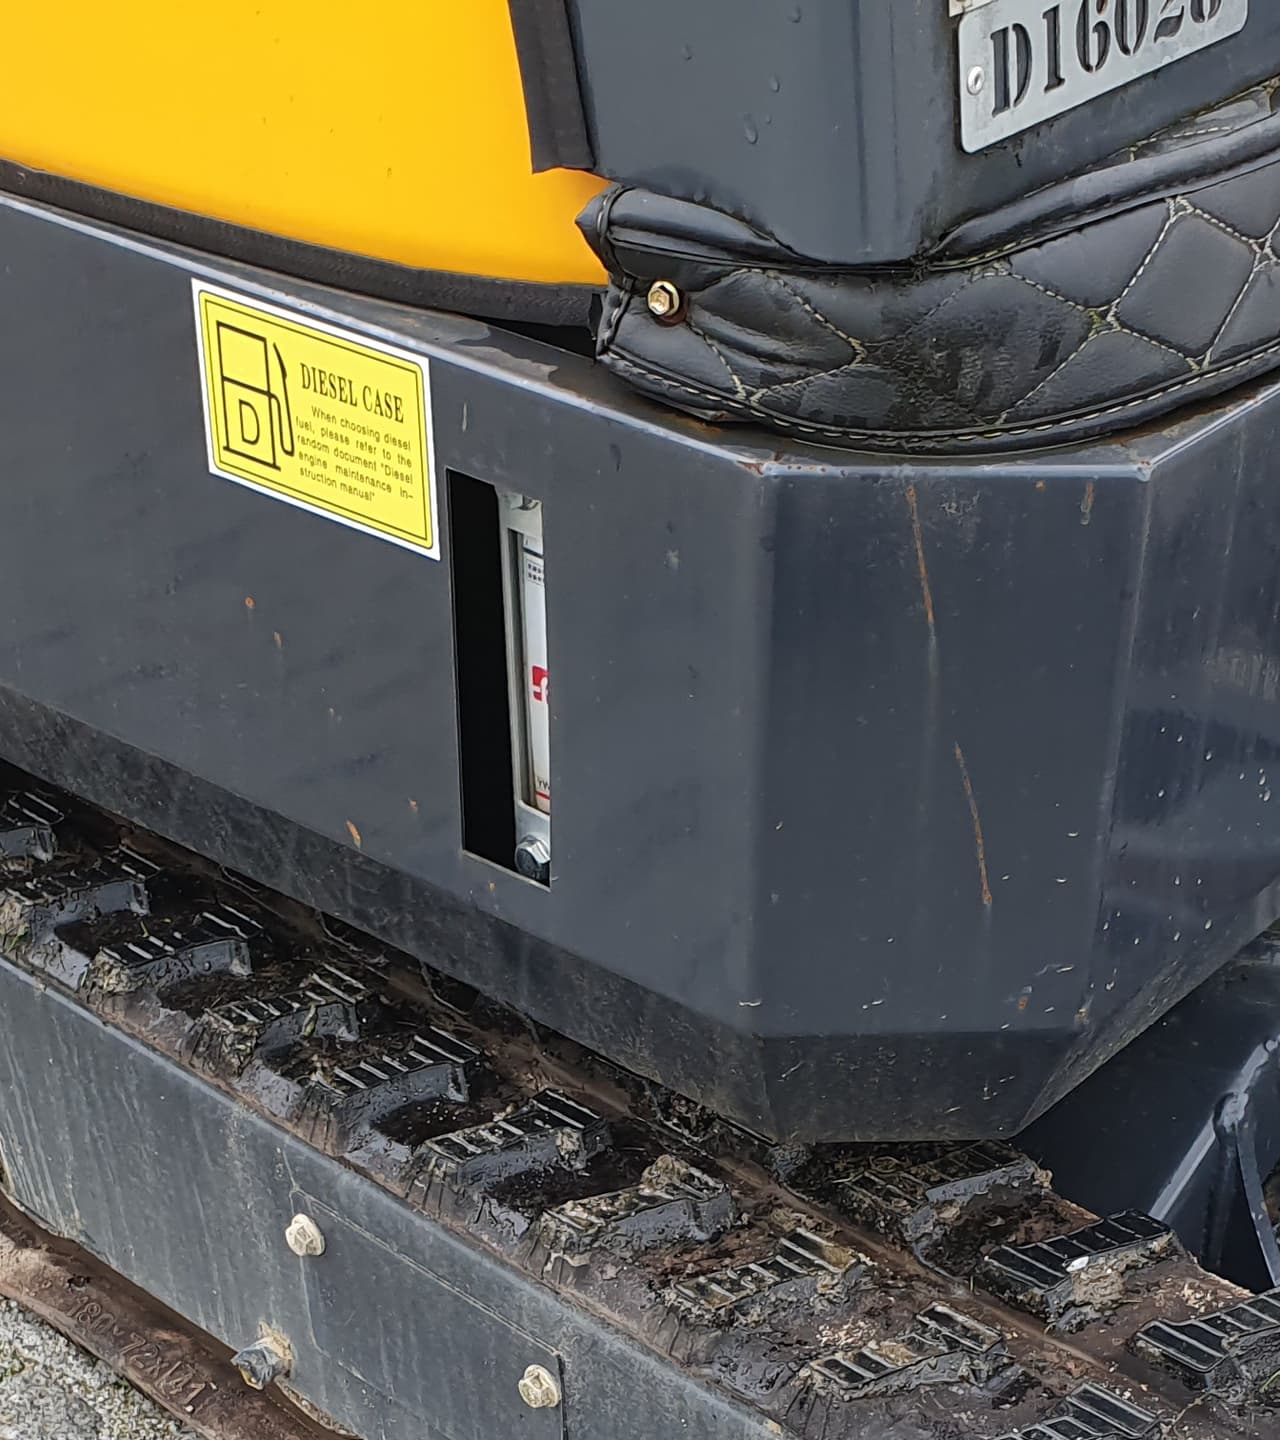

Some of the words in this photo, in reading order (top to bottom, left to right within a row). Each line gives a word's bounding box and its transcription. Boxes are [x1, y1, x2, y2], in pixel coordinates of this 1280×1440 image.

[300, 362, 358, 408] DIESEL
[362, 385, 404, 424] CASE
[238, 398, 260, 446] D
[296, 416, 315, 435] fuel,
[320, 427, 350, 445] please
[355, 440, 377, 455] refer
[382, 448, 391, 460] to
[397, 453, 412, 468] the
[311, 405, 337, 425] When
[340, 418, 380, 443] choosing
[383, 433, 411, 451] diesel
[297, 434, 330, 454] random
[333, 447, 377, 471] document
[298, 451, 328, 469] engine
[335, 465, 392, 493] maintenance
[300, 467, 338, 489] struction
